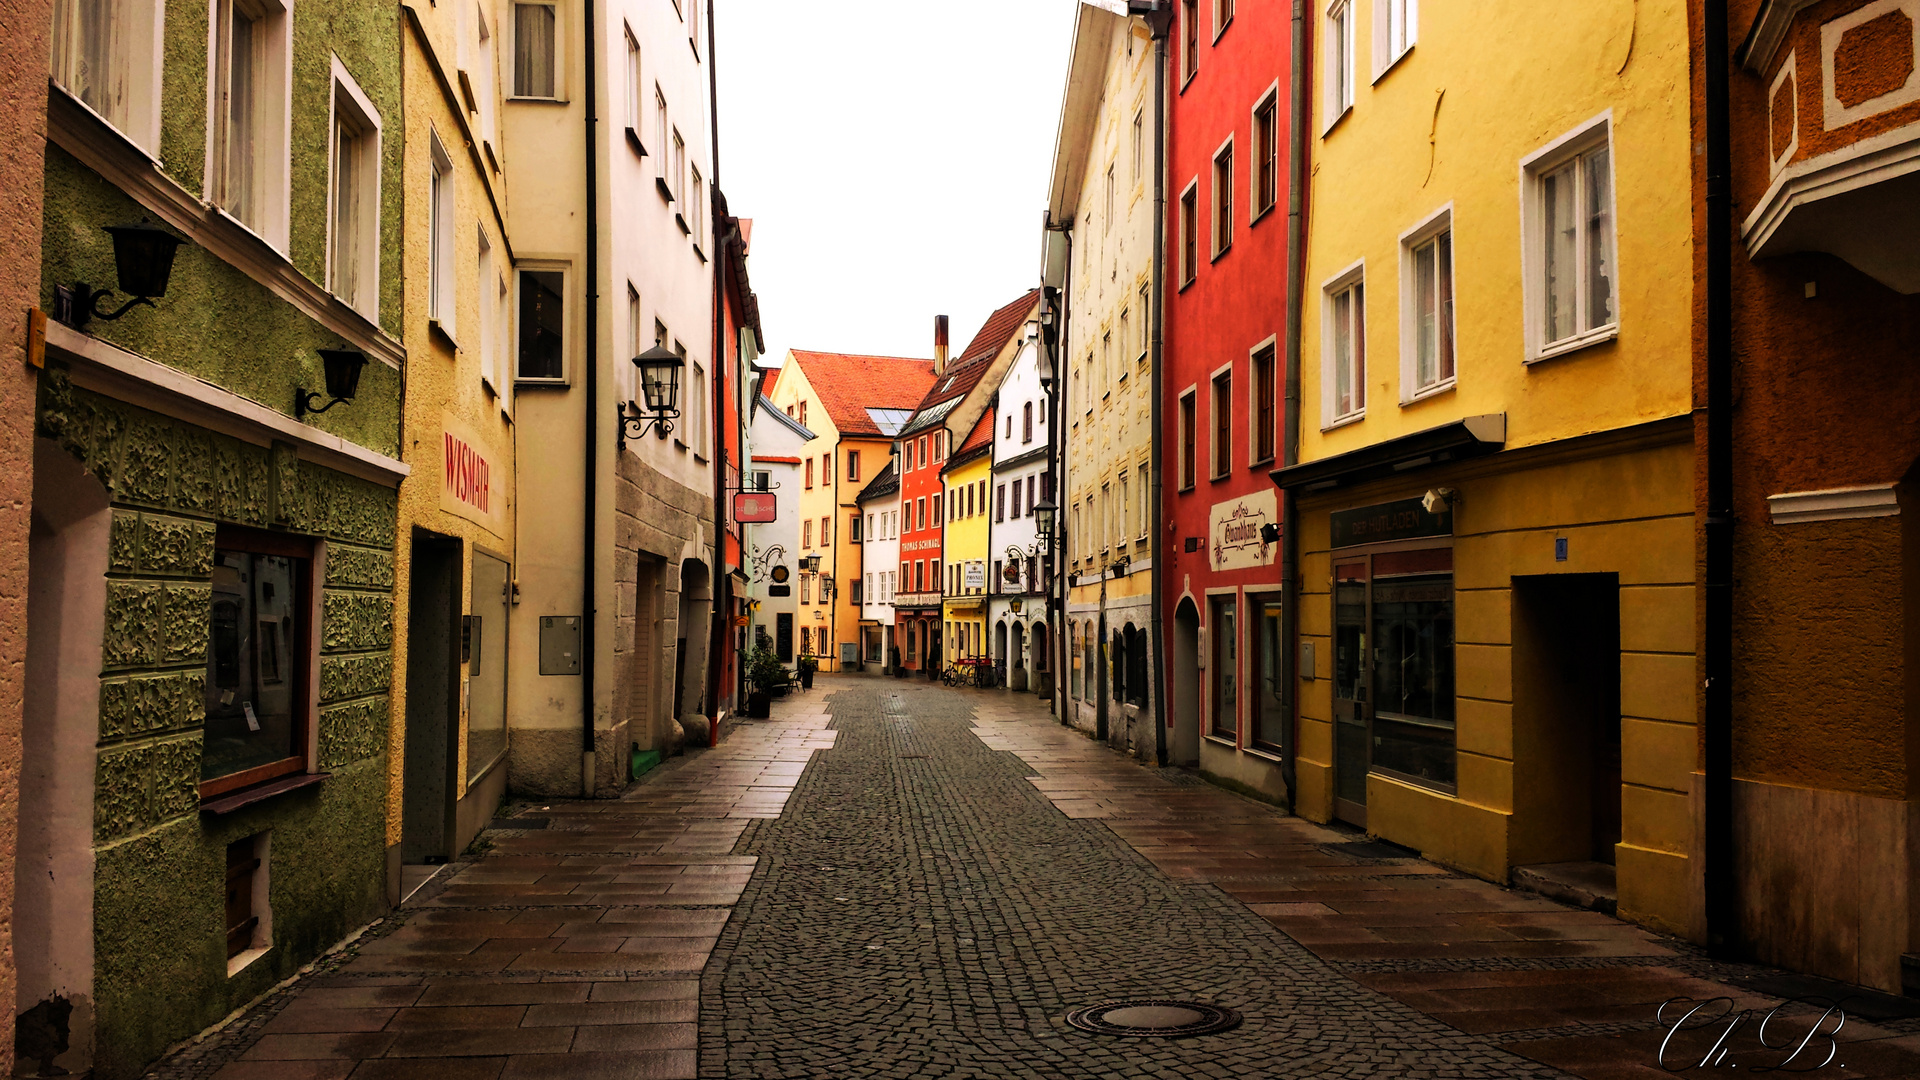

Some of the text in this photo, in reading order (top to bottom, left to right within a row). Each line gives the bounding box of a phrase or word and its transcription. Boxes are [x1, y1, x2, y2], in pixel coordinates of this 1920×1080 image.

[445, 431, 489, 514] WISMATH
[1352, 510, 1420, 536] DER HUTLADEN
[902, 541, 918, 552] THOMAS
